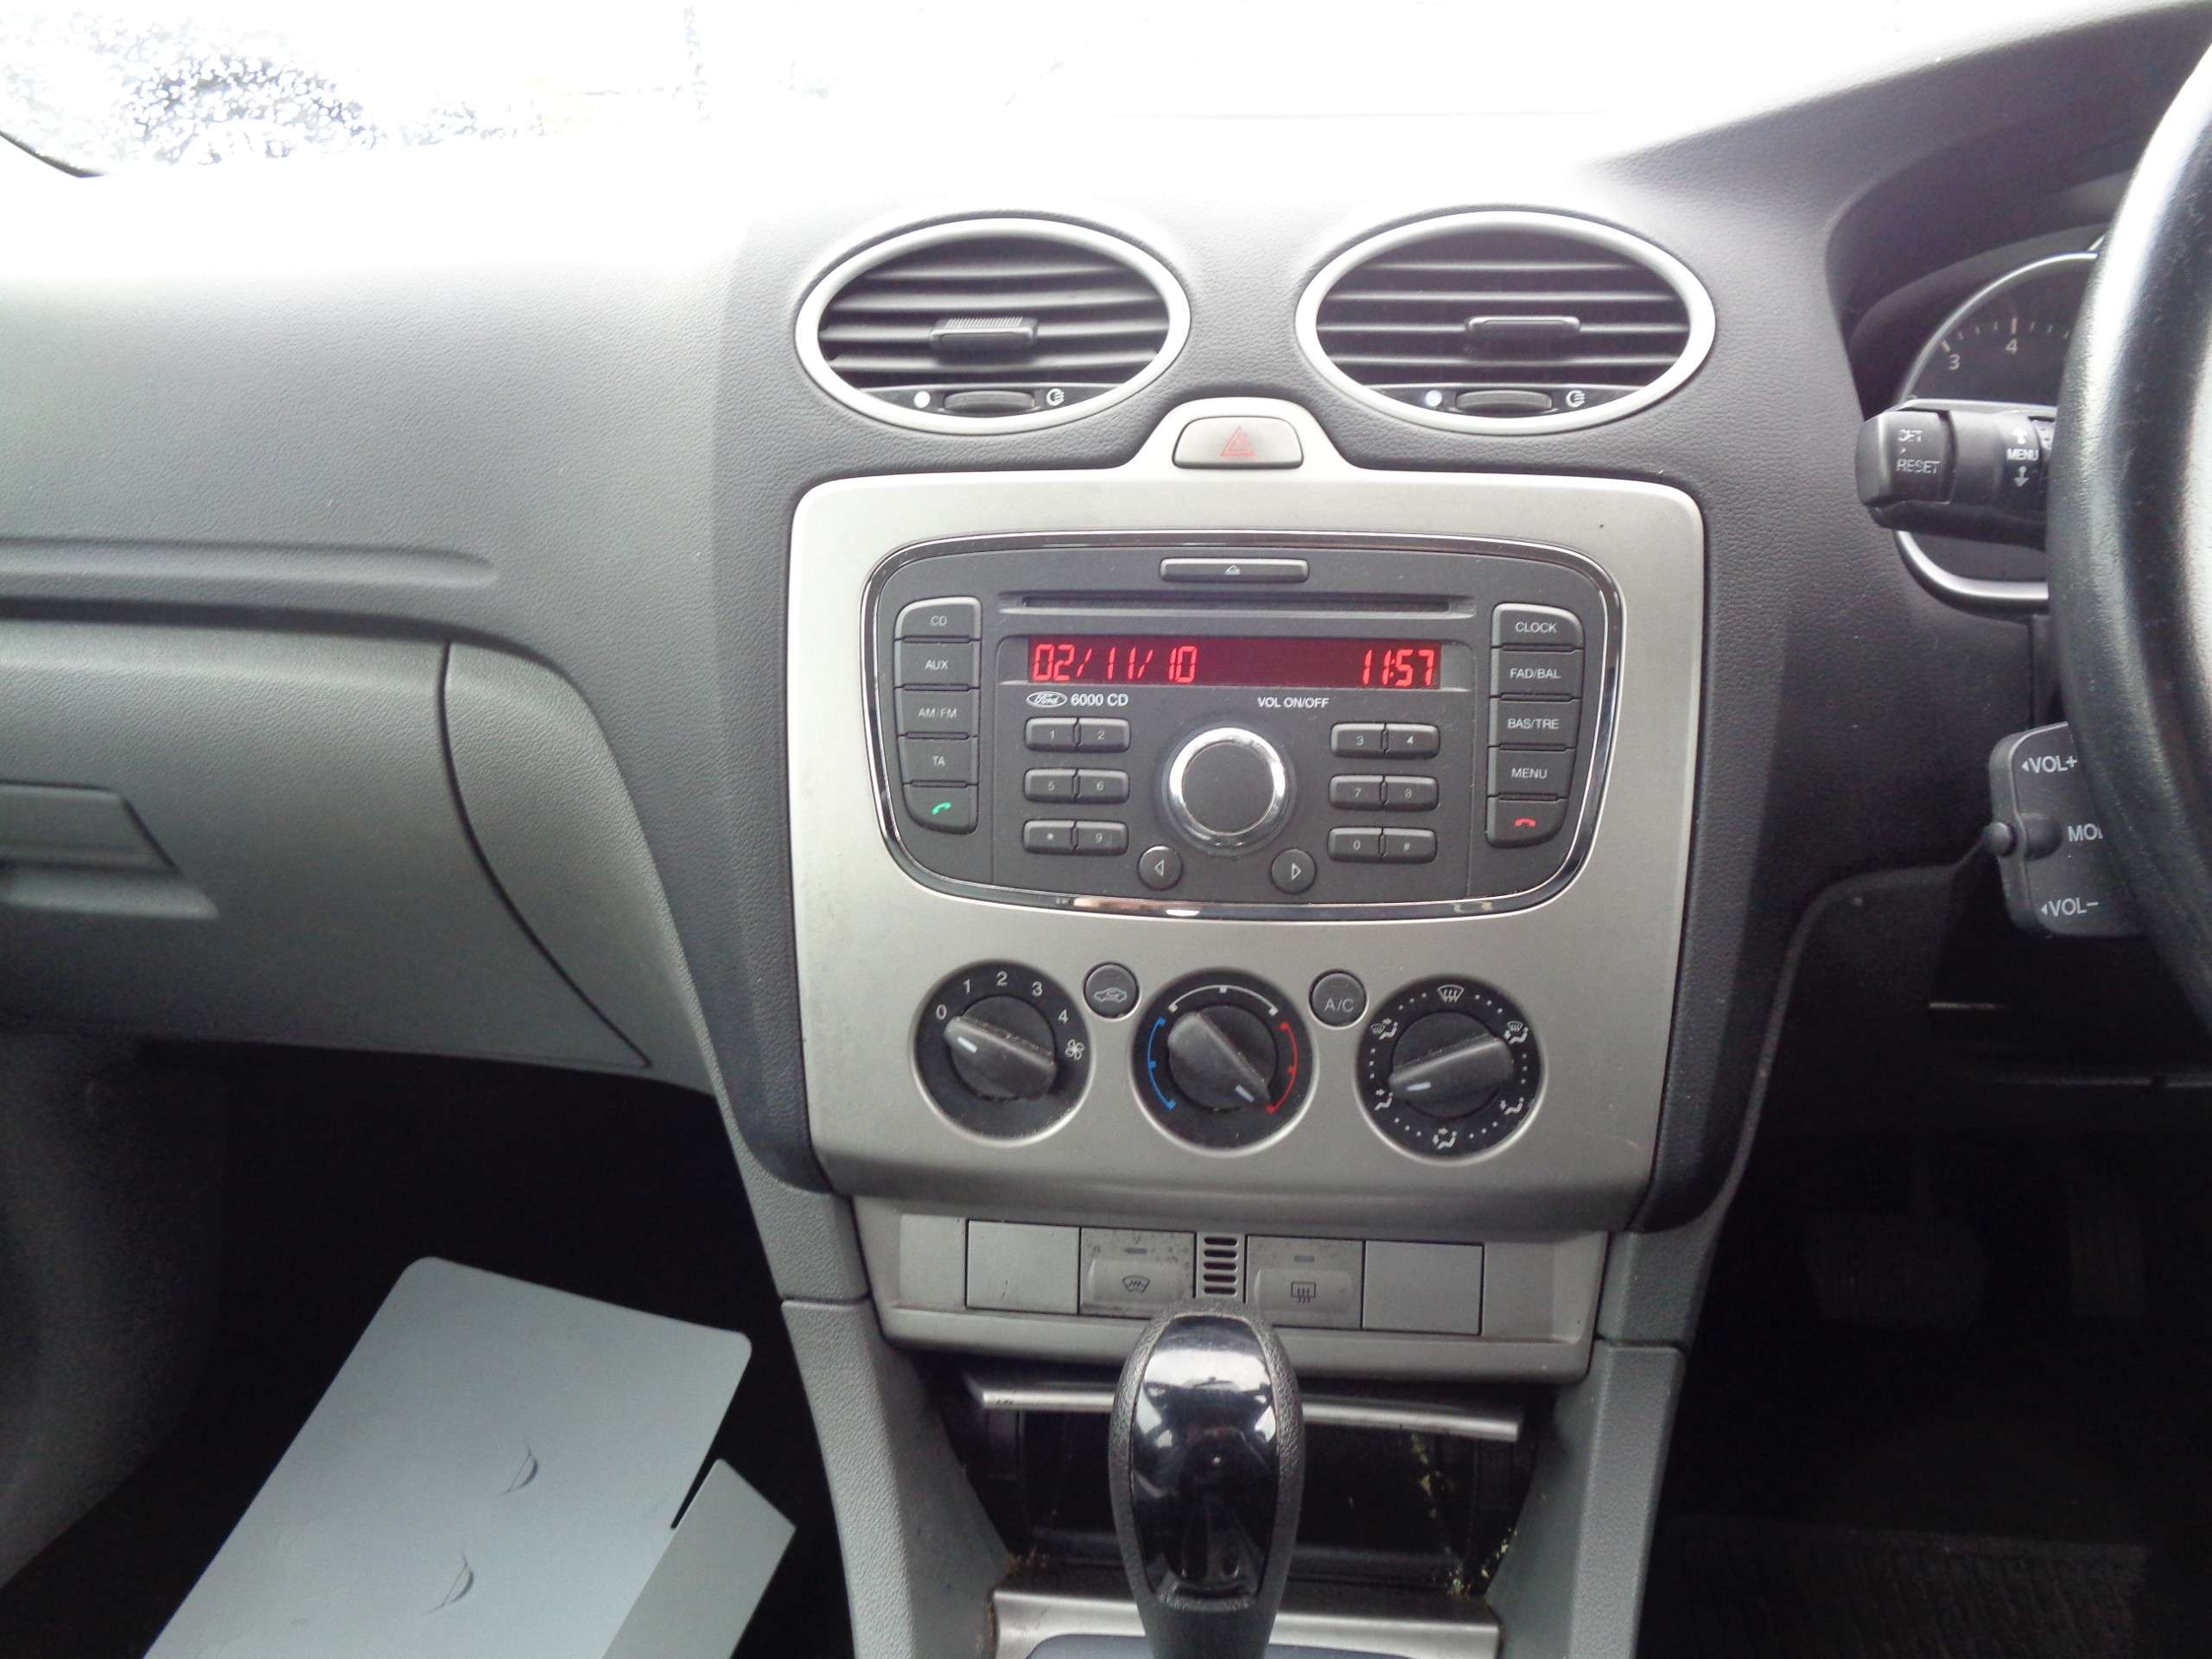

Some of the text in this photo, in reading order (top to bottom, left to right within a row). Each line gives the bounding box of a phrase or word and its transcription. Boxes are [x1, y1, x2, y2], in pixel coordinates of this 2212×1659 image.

[2005, 338, 2018, 355] 4
[1948, 354, 1961, 371] 3
[2006, 448, 2039, 461] MENU
[1896, 459, 1942, 474] RESET
[930, 614, 948, 626] CD
[1514, 621, 1558, 635] CLOCK
[925, 659, 949, 671] AUX
[1361, 648, 1436, 688] 11:57
[1510, 667, 1561, 681] FAD/BAL
[1031, 692, 1128, 707] Ford 6000 CD
[1257, 696, 1330, 709] VOL ON/OFF
[918, 707, 957, 720] AM/FM
[1507, 717, 1560, 731] BAS/TRE
[1049, 730, 1056, 740] 1
[1097, 730, 1105, 741] 2
[1356, 734, 1364, 746] 3
[1406, 734, 1414, 746] 4
[931, 756, 946, 767] TA
[1510, 767, 1548, 780] MENU
[1354, 787, 1362, 798] 7
[996, 971, 1008, 987] 2
[963, 979, 971, 994] 1
[1032, 982, 1044, 997] 3
[936, 1004, 948, 1020] 0
[1324, 997, 1354, 1013] A/C
[1058, 1009, 1069, 1024] 4
